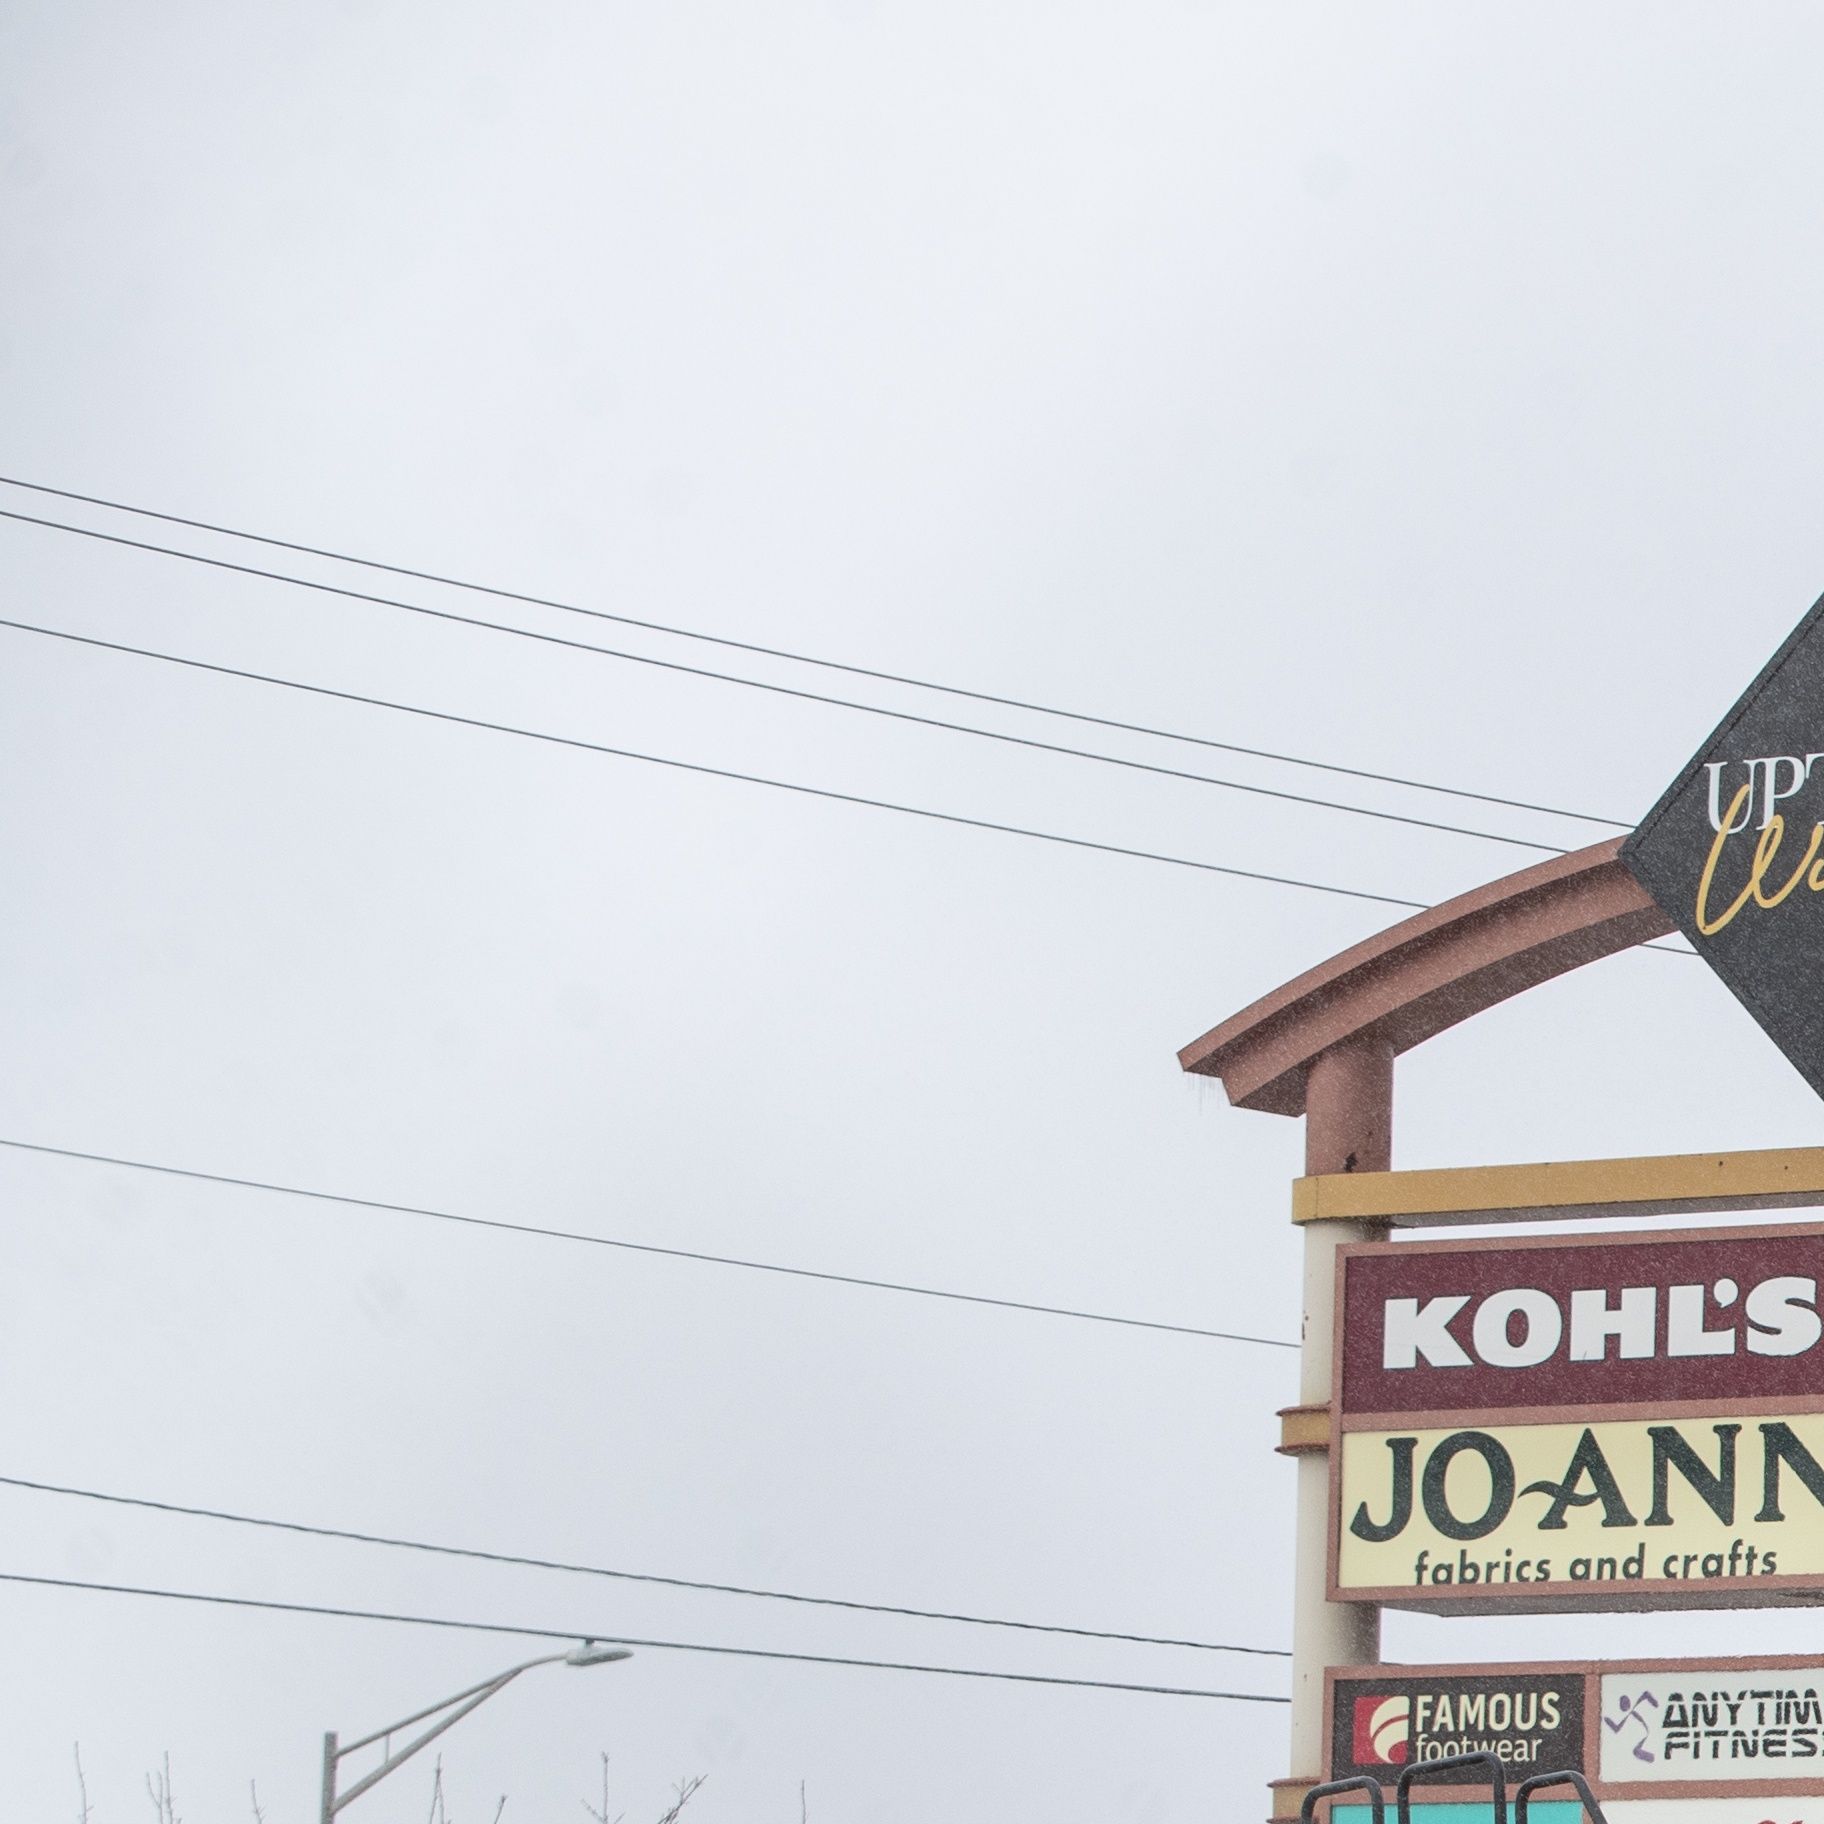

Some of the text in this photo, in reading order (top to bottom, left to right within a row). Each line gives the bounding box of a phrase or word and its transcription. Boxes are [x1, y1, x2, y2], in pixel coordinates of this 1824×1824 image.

[1383, 1276, 1823, 1370] KOHL'S
[1415, 1539, 1779, 1586] fabrics and crafts
[1415, 1692, 1561, 1732] FAMOUS
[1415, 1734, 1543, 1763] footwear
